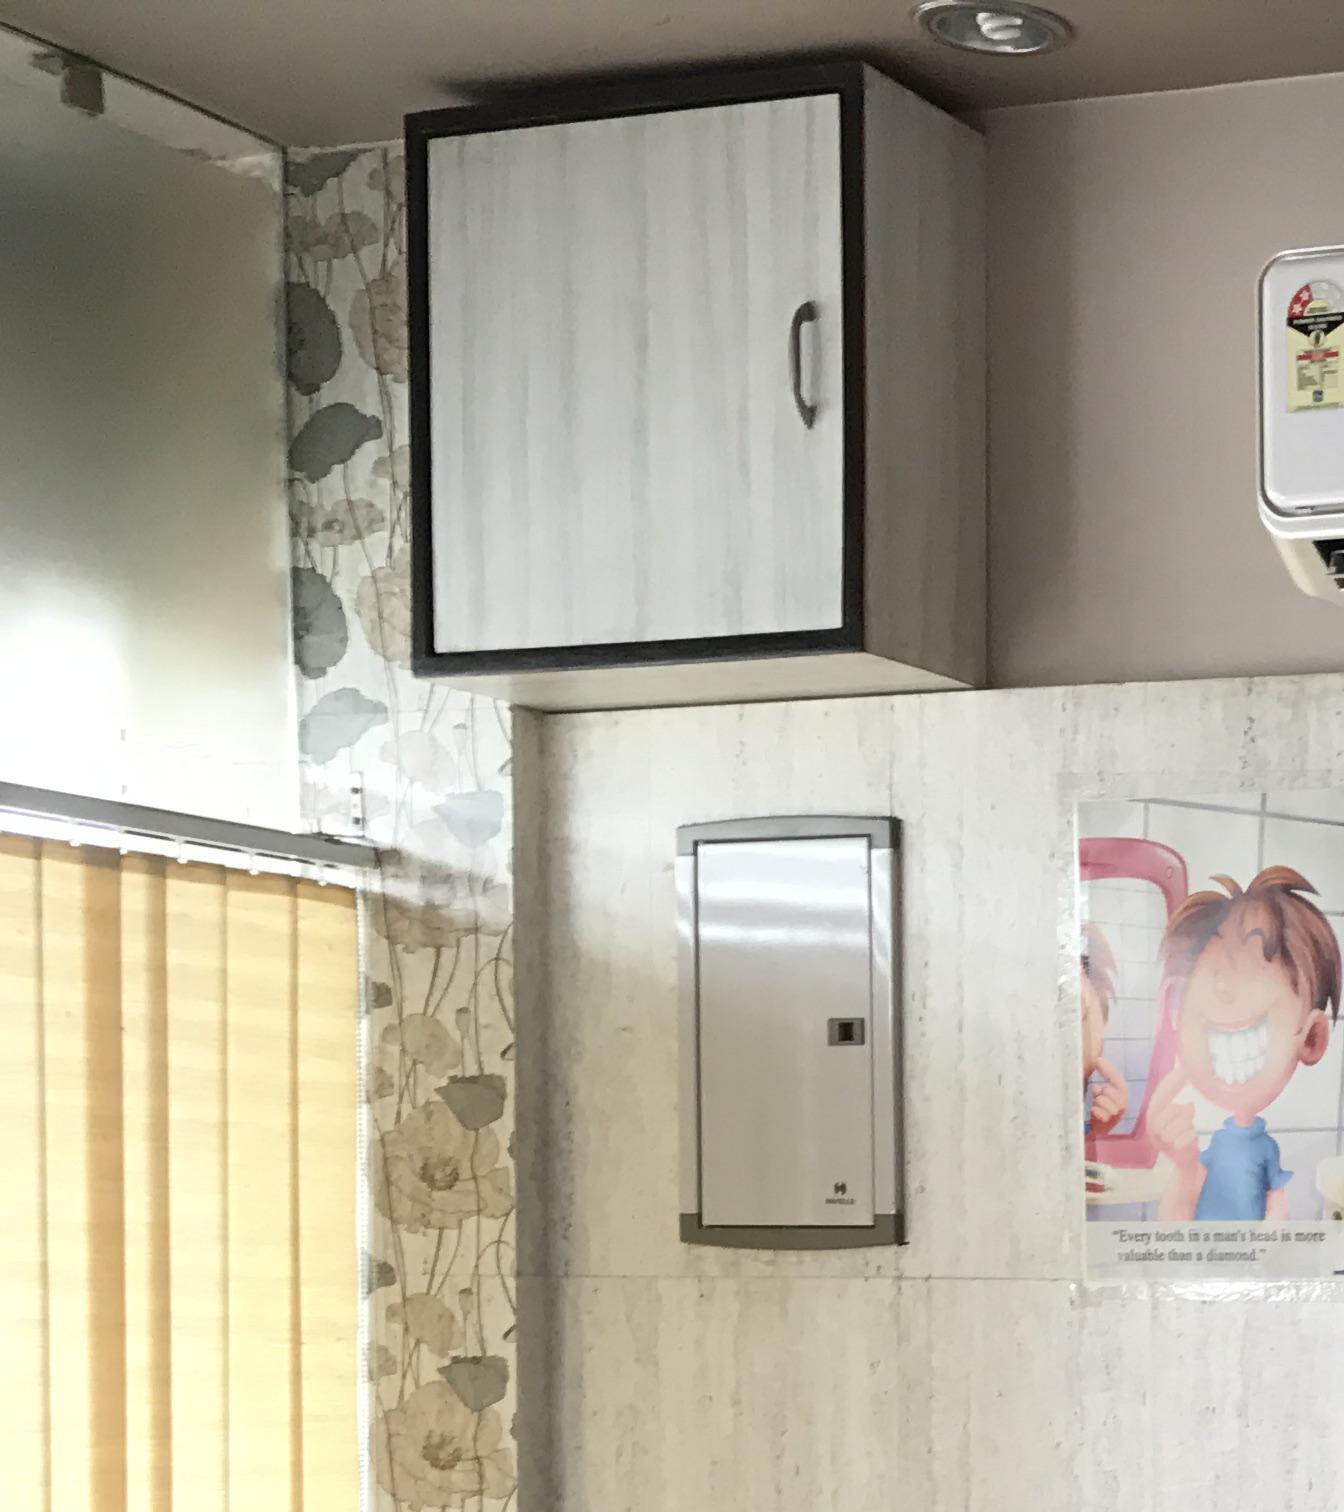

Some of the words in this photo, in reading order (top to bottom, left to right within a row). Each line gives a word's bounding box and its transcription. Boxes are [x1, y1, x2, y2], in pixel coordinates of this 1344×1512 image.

[1155, 1229, 1184, 1242] tooth
[1188, 1229, 1200, 1241] in
[1213, 1229, 1246, 1241] man's
[1249, 1229, 1278, 1242] head
[1281, 1229, 1292, 1242] is
[1294, 1231, 1326, 1242] more
[1117, 1248, 1165, 1262] valuable
[1167, 1249, 1192, 1261] than
